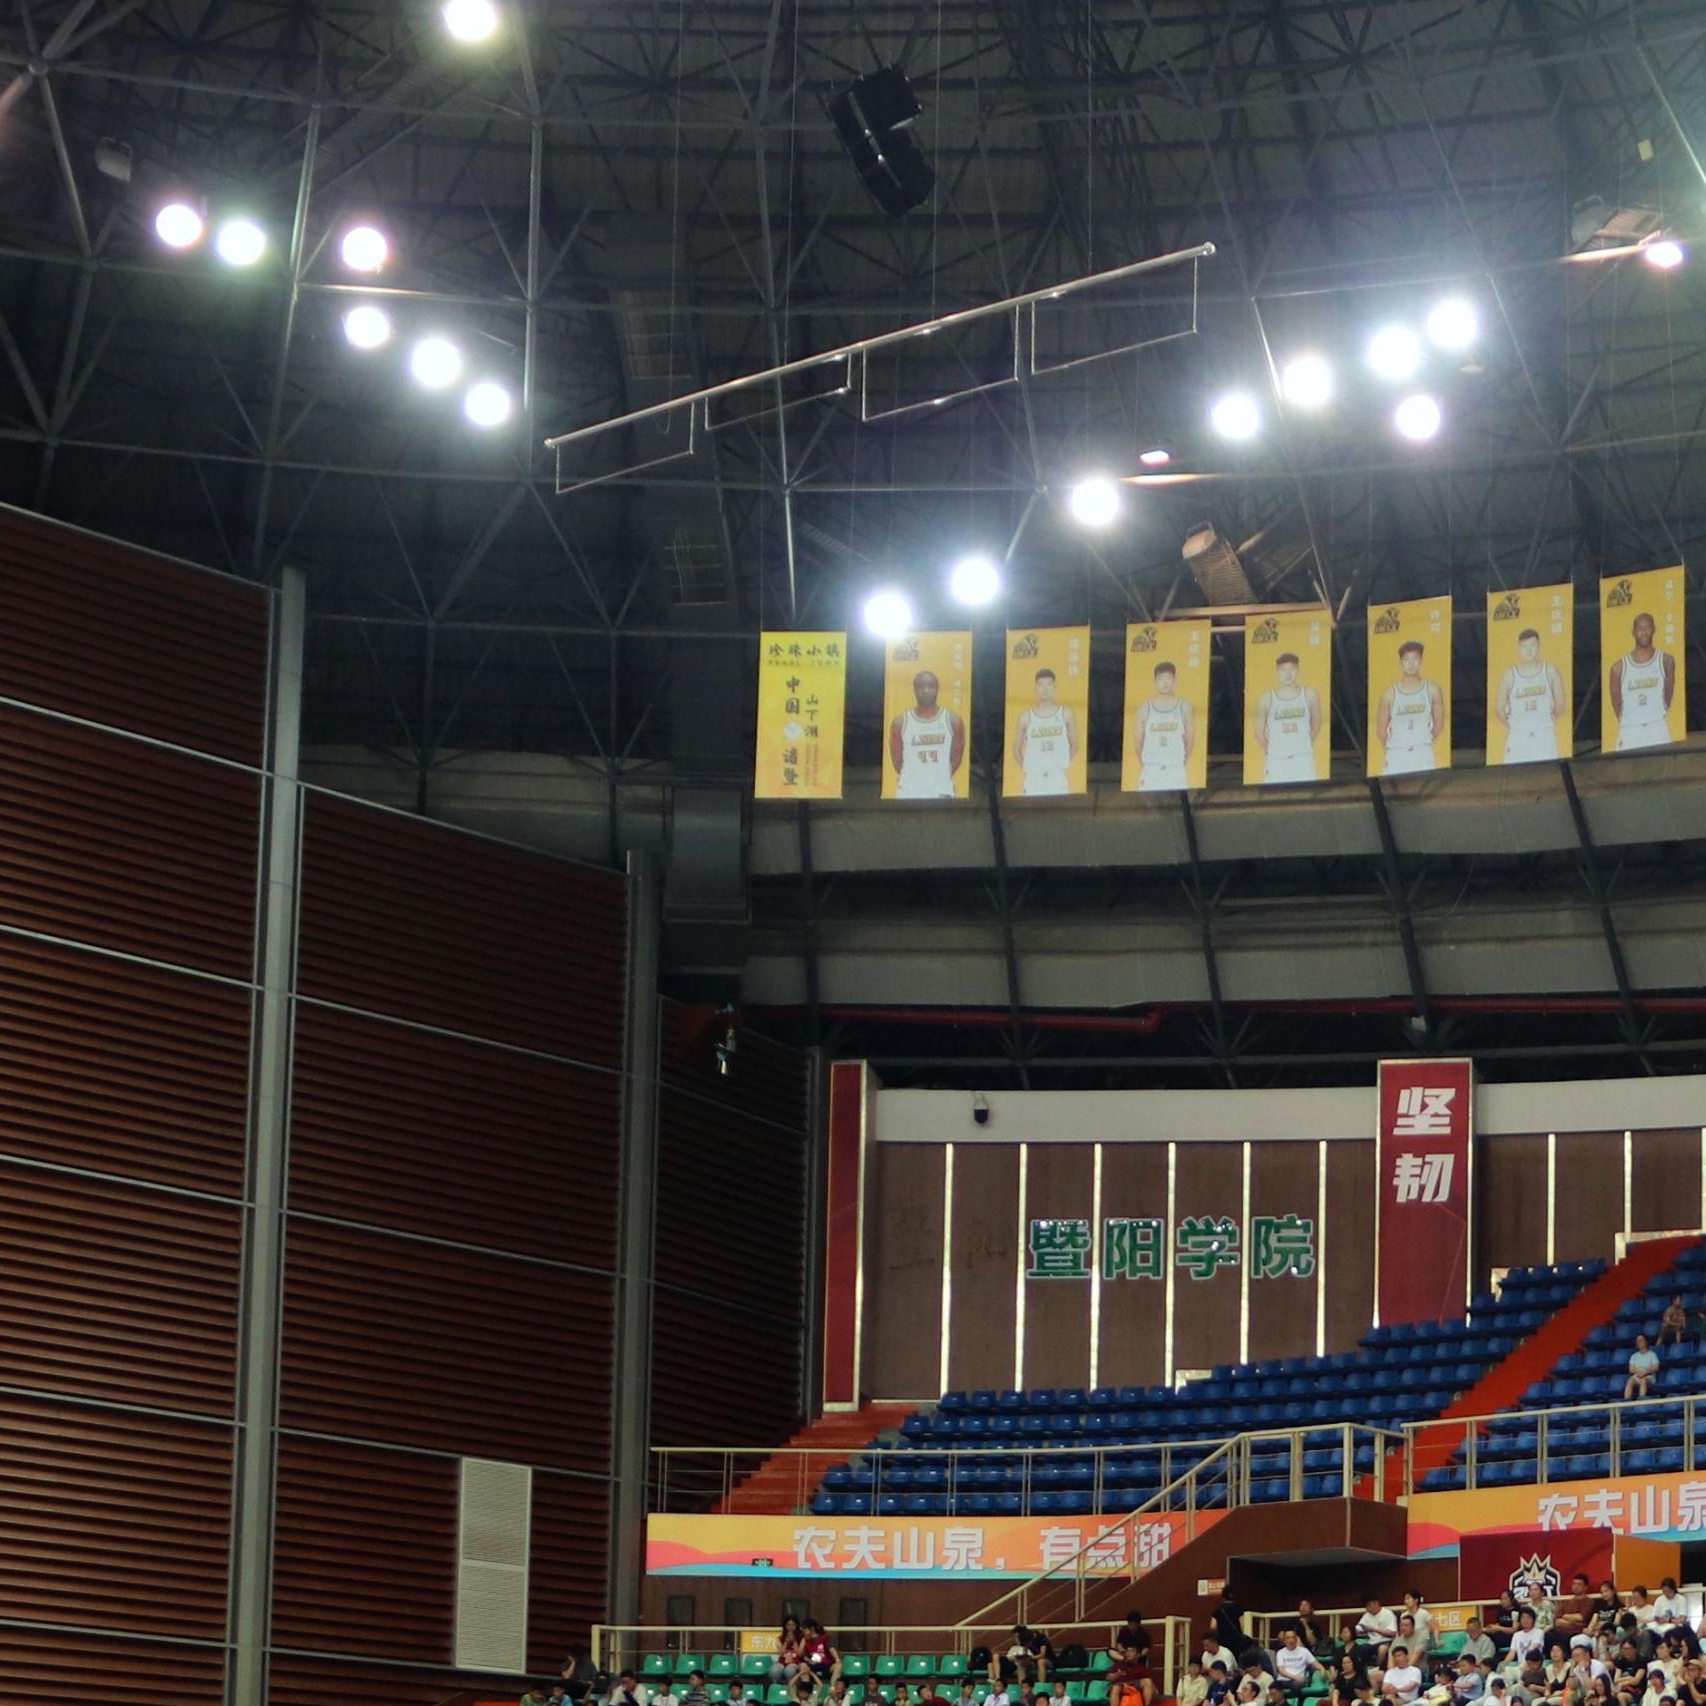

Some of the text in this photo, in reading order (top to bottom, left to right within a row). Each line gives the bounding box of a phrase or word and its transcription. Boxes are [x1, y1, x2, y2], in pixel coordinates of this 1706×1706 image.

[1392, 1086, 1456, 1204] 坚韧
[1025, 1213, 1316, 1280] 暨阳学院
